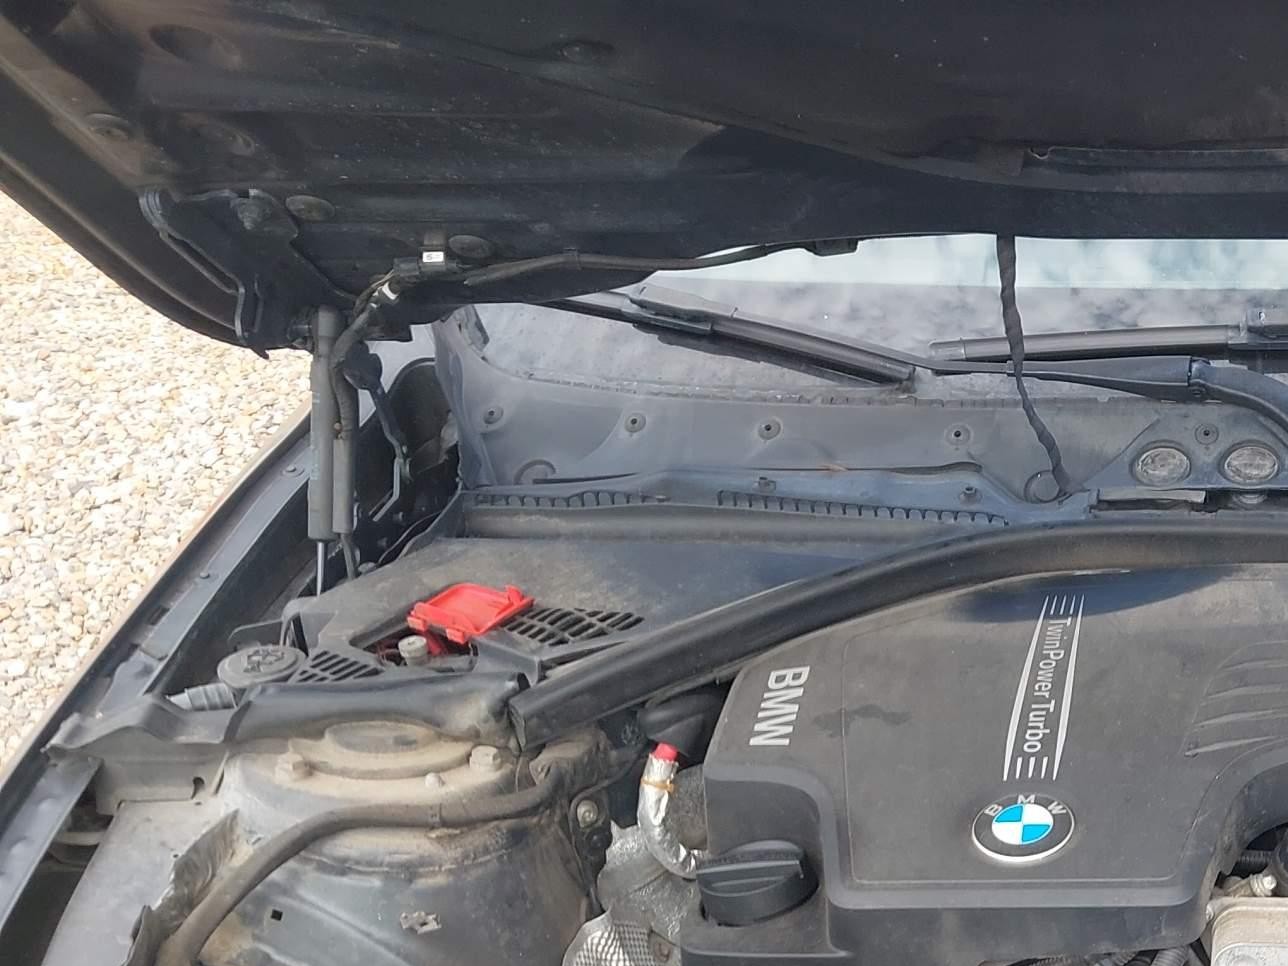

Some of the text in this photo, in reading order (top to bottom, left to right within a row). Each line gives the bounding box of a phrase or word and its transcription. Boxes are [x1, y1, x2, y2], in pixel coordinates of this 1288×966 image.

[748, 664, 810, 747] BMW
[1022, 617, 1073, 754] TwinPower Turbo
[983, 794, 1067, 817] BMW
